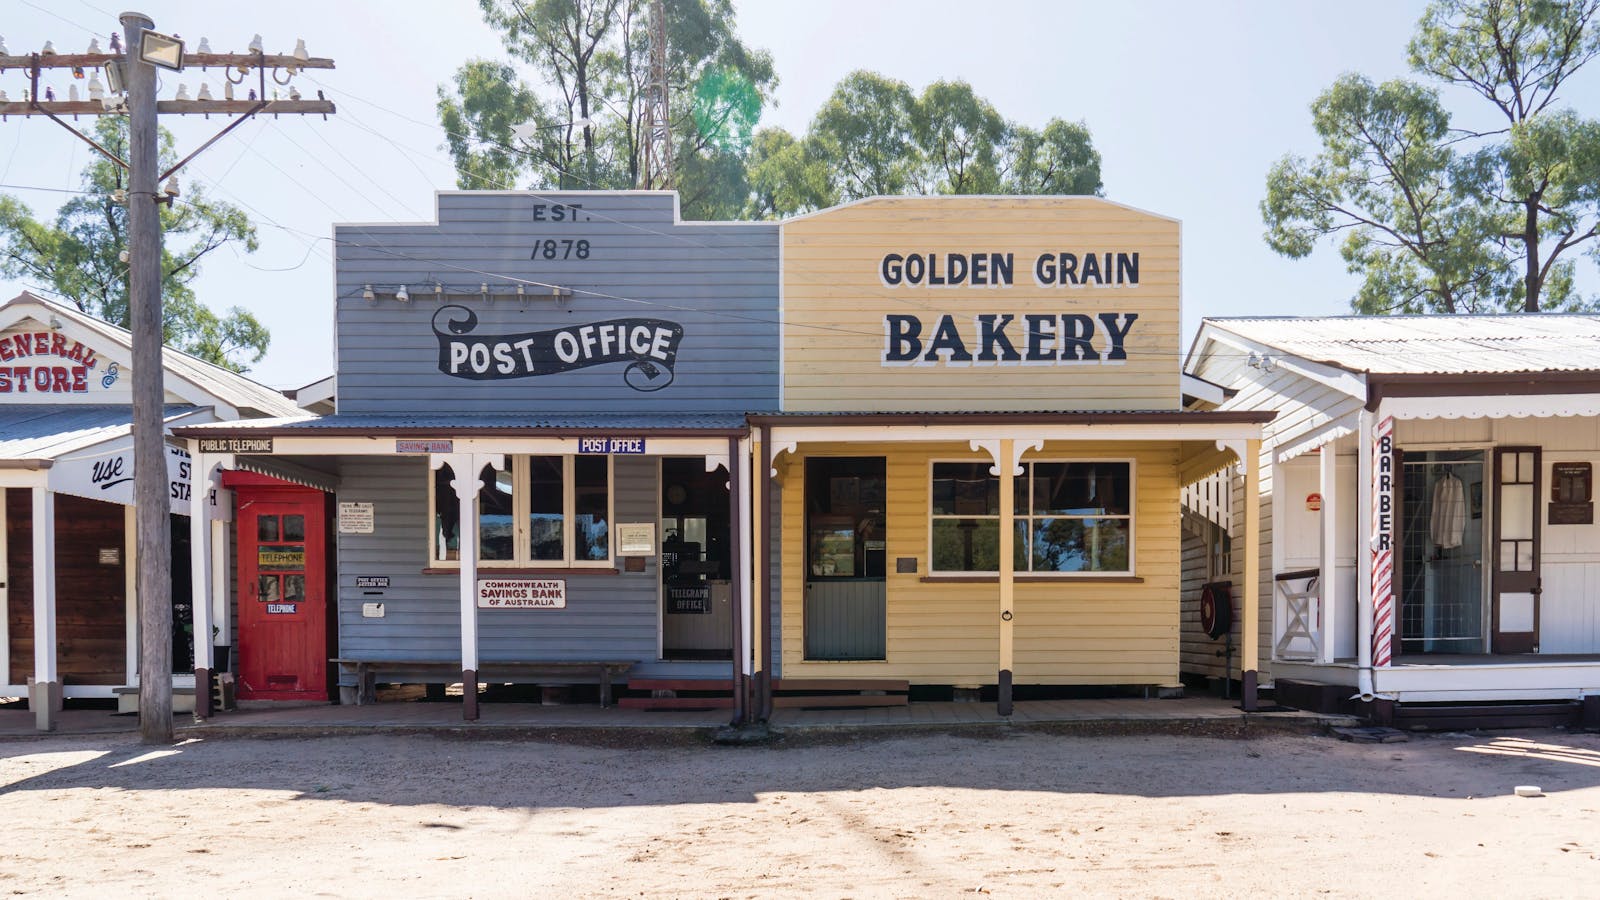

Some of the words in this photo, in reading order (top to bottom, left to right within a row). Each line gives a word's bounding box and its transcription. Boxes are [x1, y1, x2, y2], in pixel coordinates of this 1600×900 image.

[532, 204, 591, 222] EST.
[530, 239, 591, 261] 1878
[880, 252, 1014, 288] GOLDEN
[1033, 252, 1139, 288] GRAIN
[450, 338, 535, 374] POST
[554, 325, 673, 365] OFFICE
[882, 313, 1139, 366] BAKERY
[0, 332, 97, 369] ENERAL
[0, 366, 88, 393] STORE
[200, 439, 227, 451] PUBLIC
[228, 439, 271, 451] TELEPHONE
[431, 442, 451, 451] BANK
[582, 439, 607, 452] POST
[610, 439, 642, 452] OFFICE
[92, 456, 124, 484] use
[1379, 436, 1391, 551] BARBER
[261, 553, 304, 563] TELEPHONE
[481, 589, 527, 599] SAVINGS
[532, 589, 562, 599] BANK
[671, 588, 709, 599] TELEGRAPH
[677, 599, 703, 610] OFFICE
